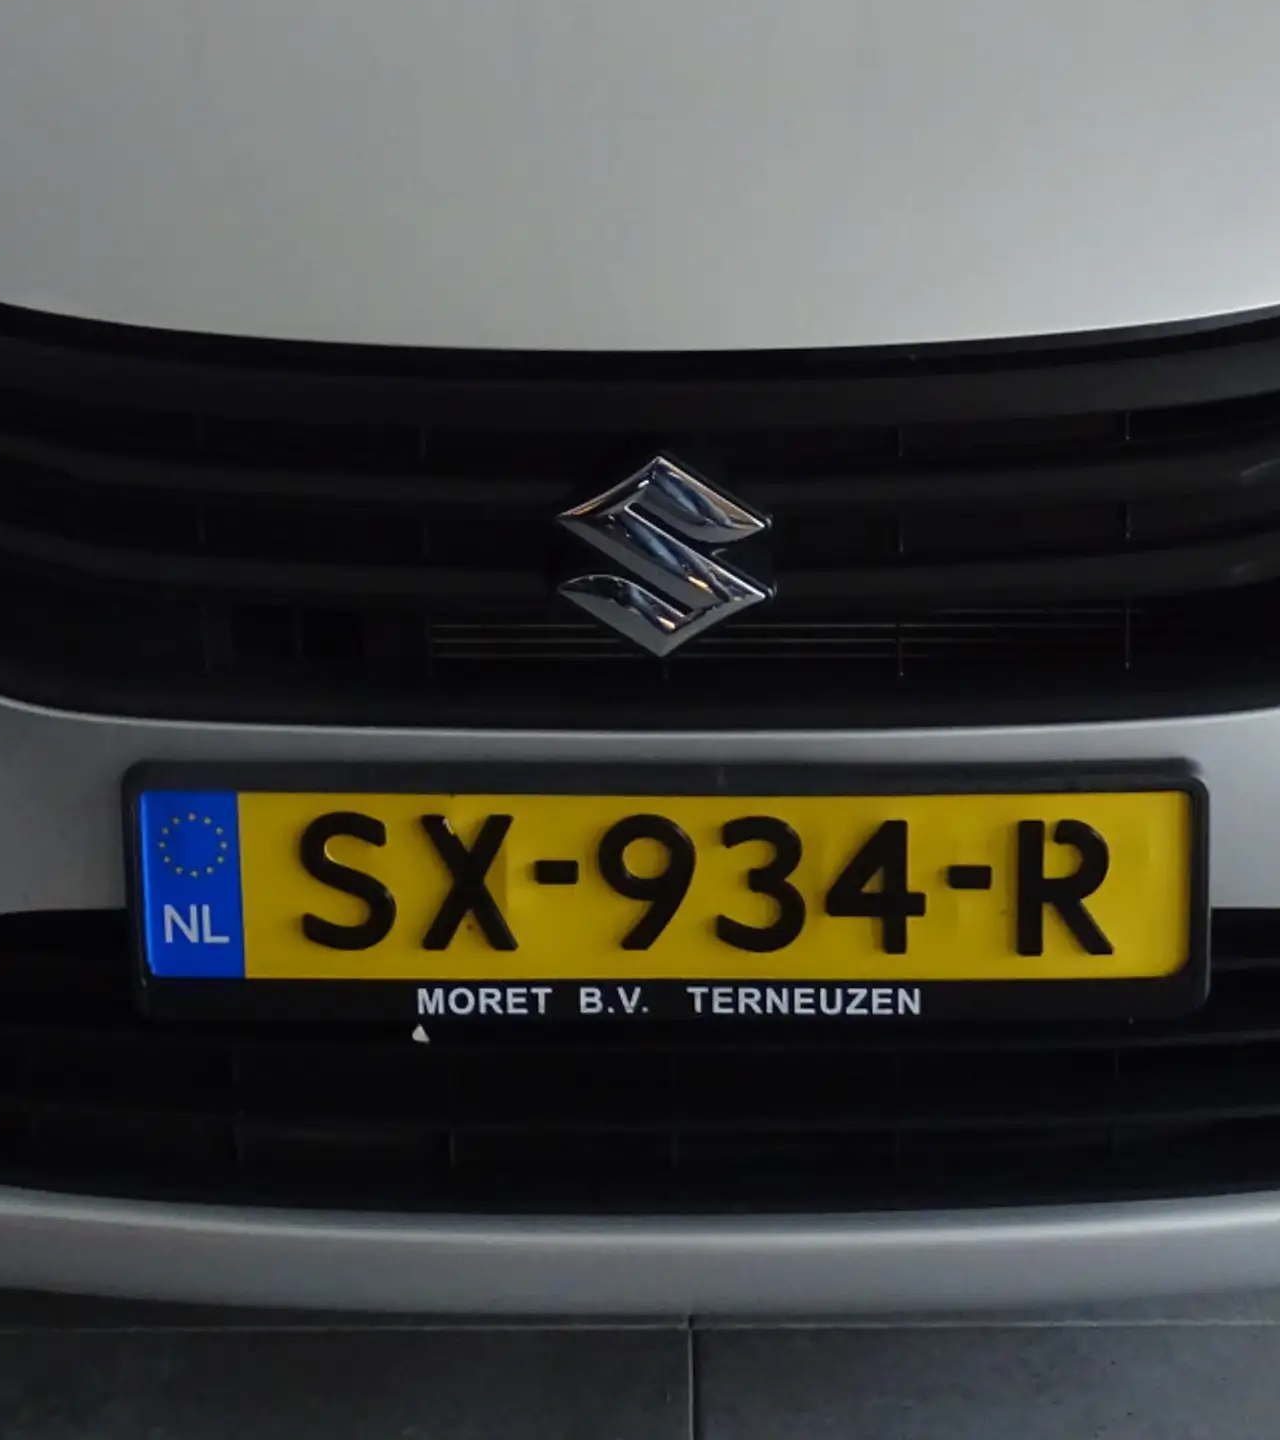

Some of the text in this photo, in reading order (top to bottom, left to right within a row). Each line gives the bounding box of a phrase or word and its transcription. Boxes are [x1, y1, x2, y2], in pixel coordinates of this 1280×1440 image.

[300, 812, 1114, 956] SX-934-R
[162, 905, 230, 944] NL
[417, 987, 921, 1015] MORET B.V. TERNEUZEN
